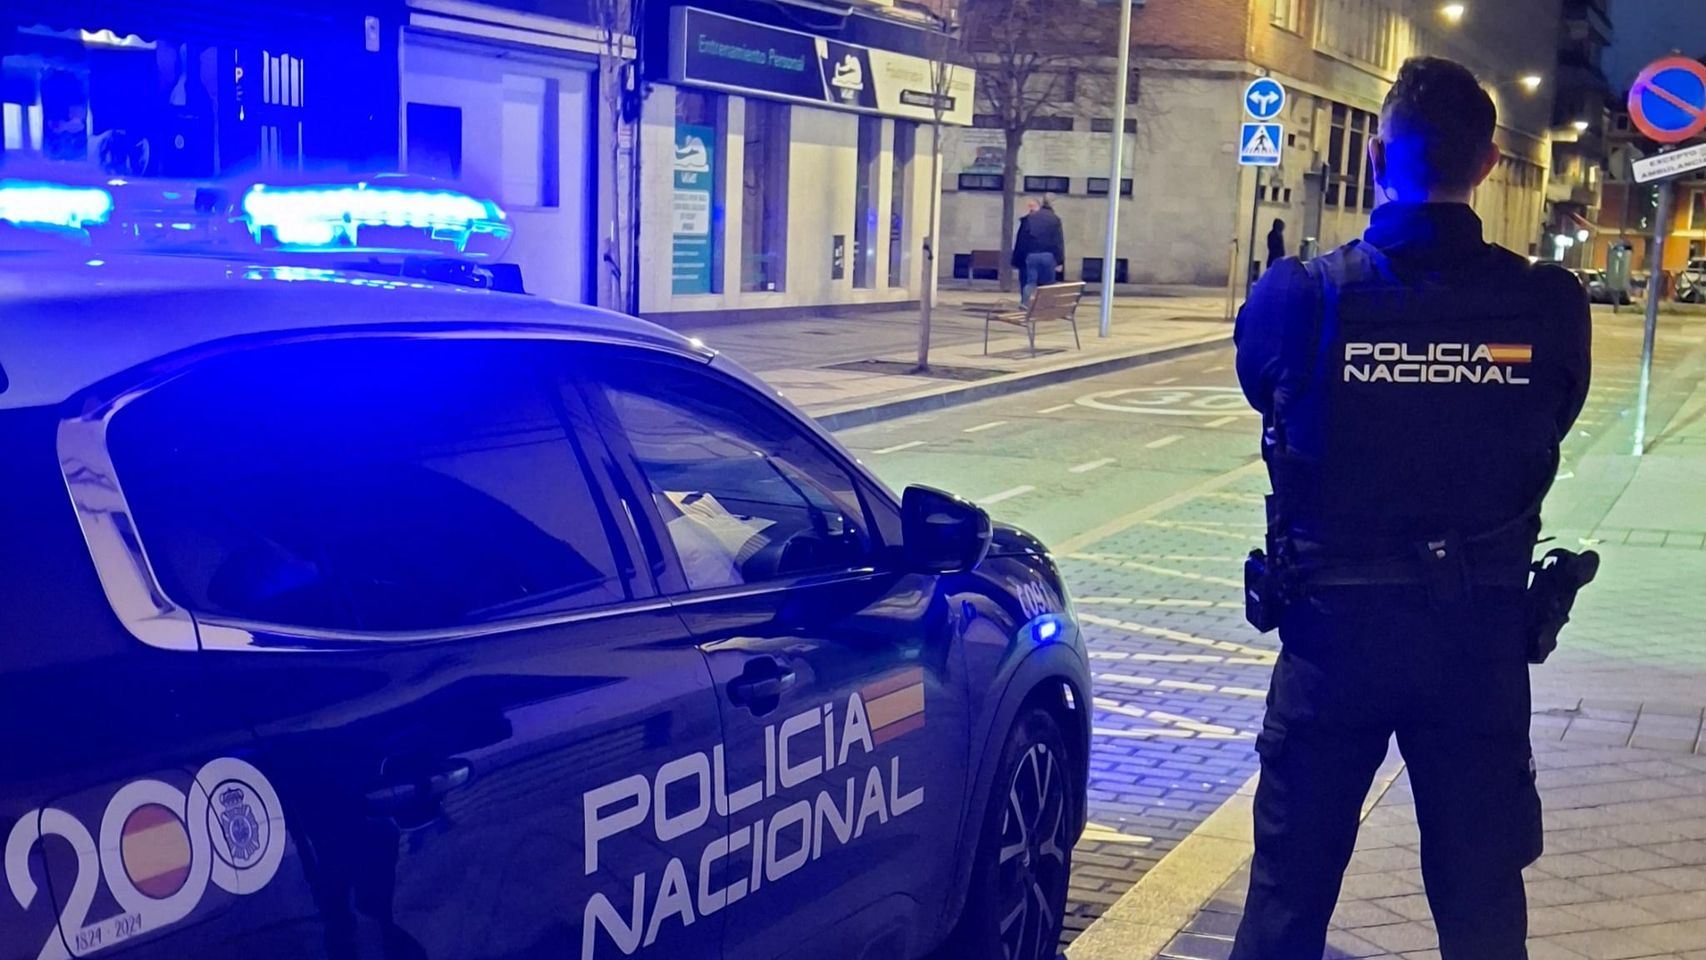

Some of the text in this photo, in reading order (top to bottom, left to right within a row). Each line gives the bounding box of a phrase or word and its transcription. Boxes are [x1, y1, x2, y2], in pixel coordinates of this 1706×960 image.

[698, 33, 805, 71] Entrenamiento Personal
[1649, 150, 1697, 167] EXCEPTO
[1343, 364, 1530, 385] NACIONAL
[1123, 391, 1246, 409] 30
[5, 757, 286, 960] 200
[582, 756, 924, 960] NACIONAL
[75, 913, 142, 951] 1824 2024
